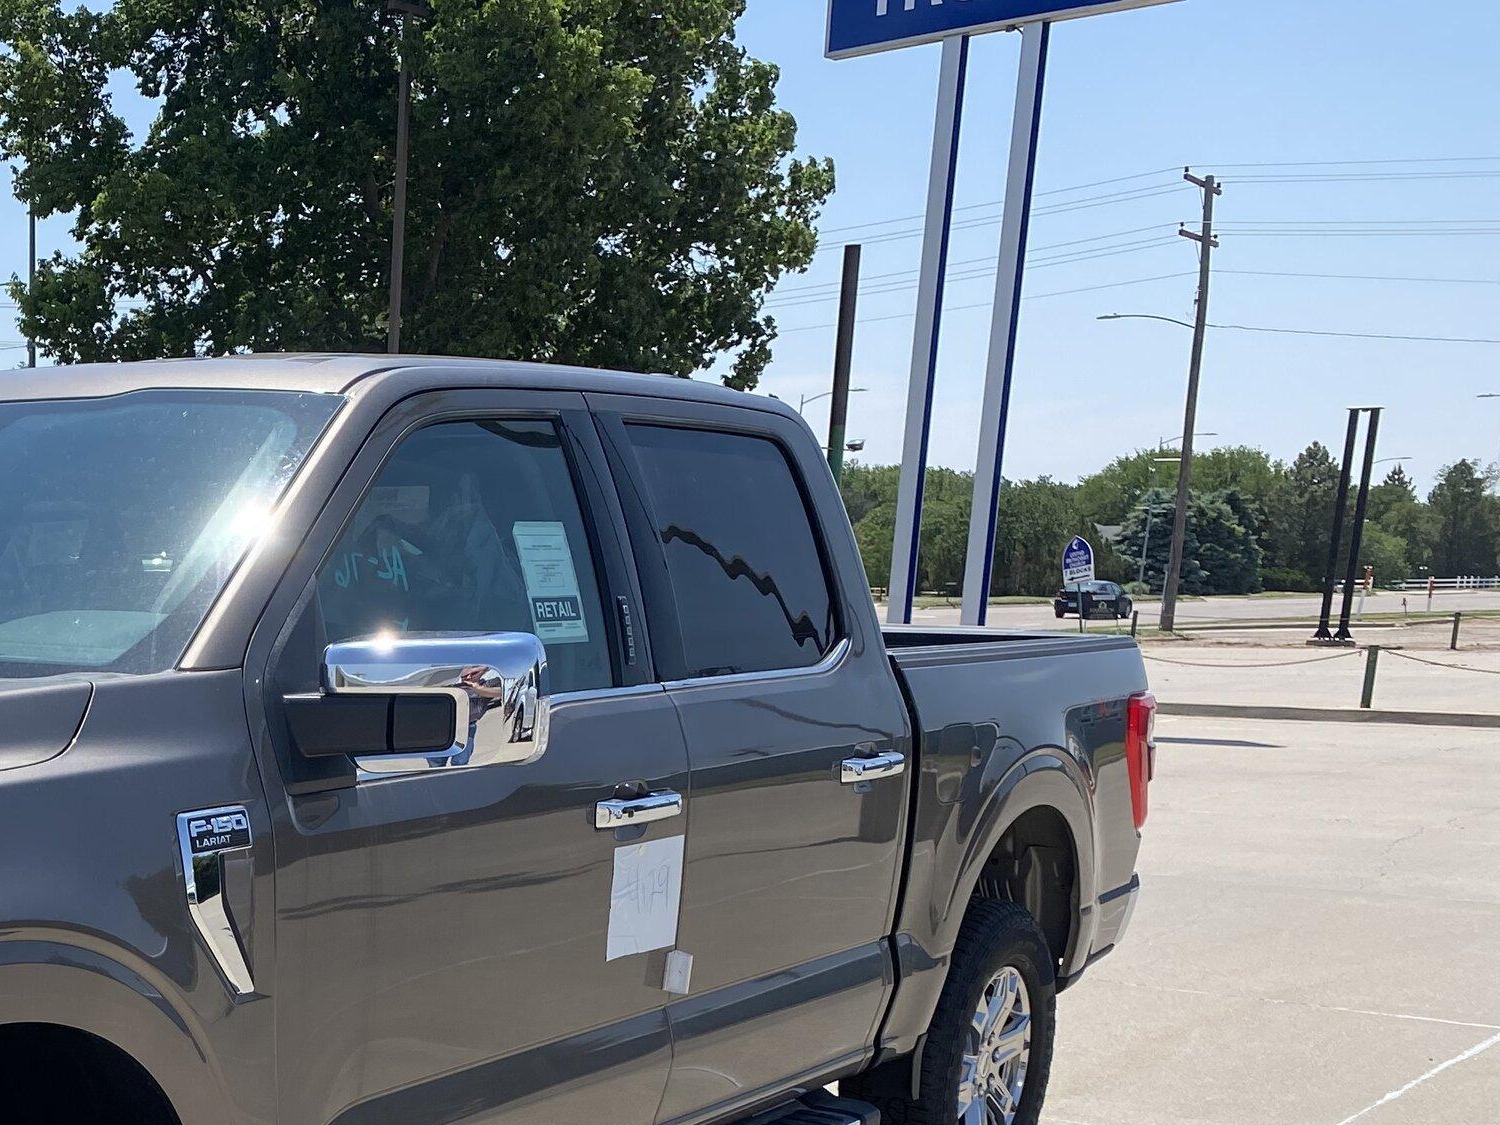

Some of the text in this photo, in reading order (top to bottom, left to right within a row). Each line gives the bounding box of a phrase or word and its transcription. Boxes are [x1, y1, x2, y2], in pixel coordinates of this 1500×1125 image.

[1069, 566, 1092, 576] BLOCKS
[535, 601, 577, 618] RETAIL
[189, 813, 248, 837] F-150
[196, 834, 232, 848] LARIAT
